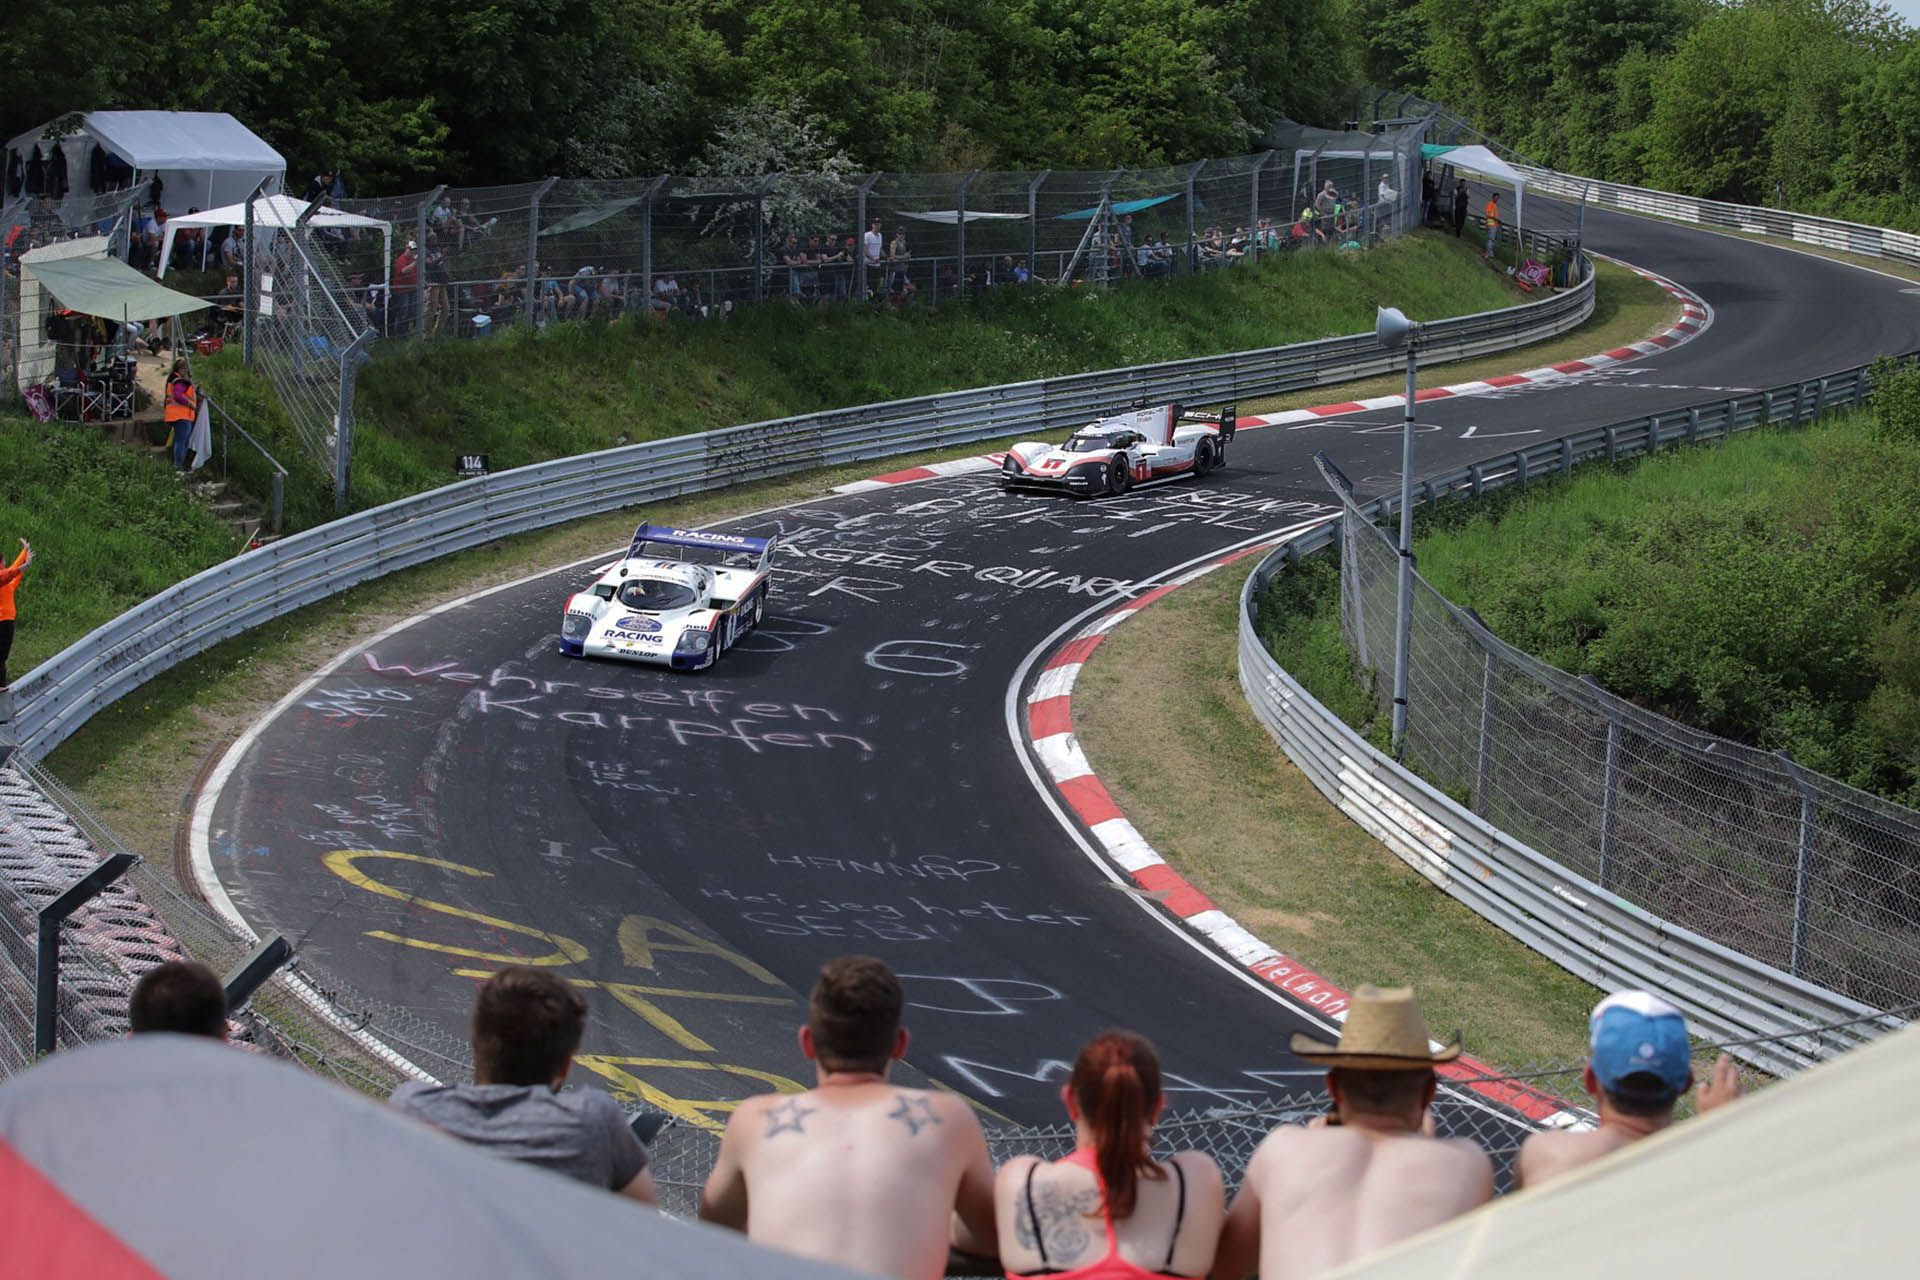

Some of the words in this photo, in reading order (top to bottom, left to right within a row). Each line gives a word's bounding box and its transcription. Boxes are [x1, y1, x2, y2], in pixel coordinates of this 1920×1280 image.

[463, 455, 481, 469] 114
[672, 530, 745, 543] RACING
[604, 629, 664, 643] RACING
[619, 648, 658, 658] DUNLOP
[363, 652, 840, 722] Wehrseifen
[478, 690, 873, 753] Karpfen
